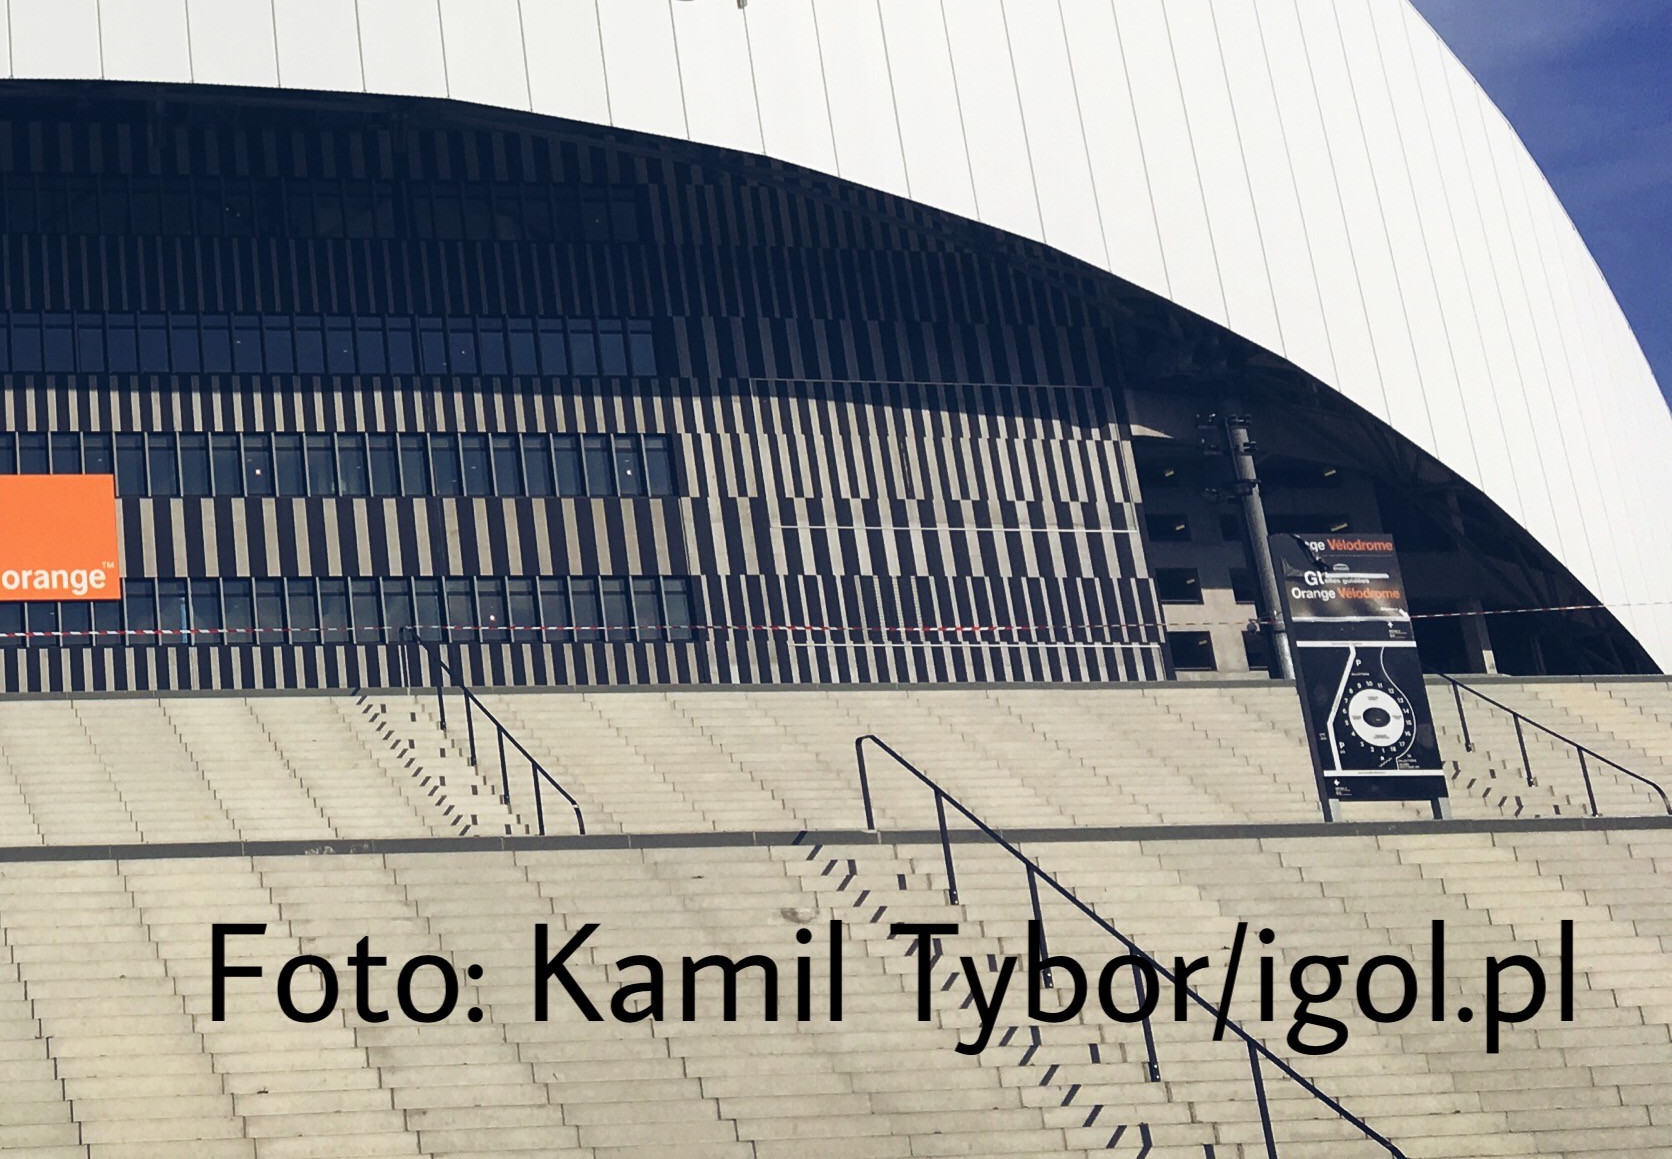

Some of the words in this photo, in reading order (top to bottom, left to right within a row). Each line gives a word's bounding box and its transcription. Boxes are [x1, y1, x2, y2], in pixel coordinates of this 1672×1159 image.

[1326, 538, 1393, 552] Vélodrome
[1, 568, 106, 596] orange
[1291, 587, 1336, 602] Orange
[1337, 586, 1401, 600] Vélodrome
